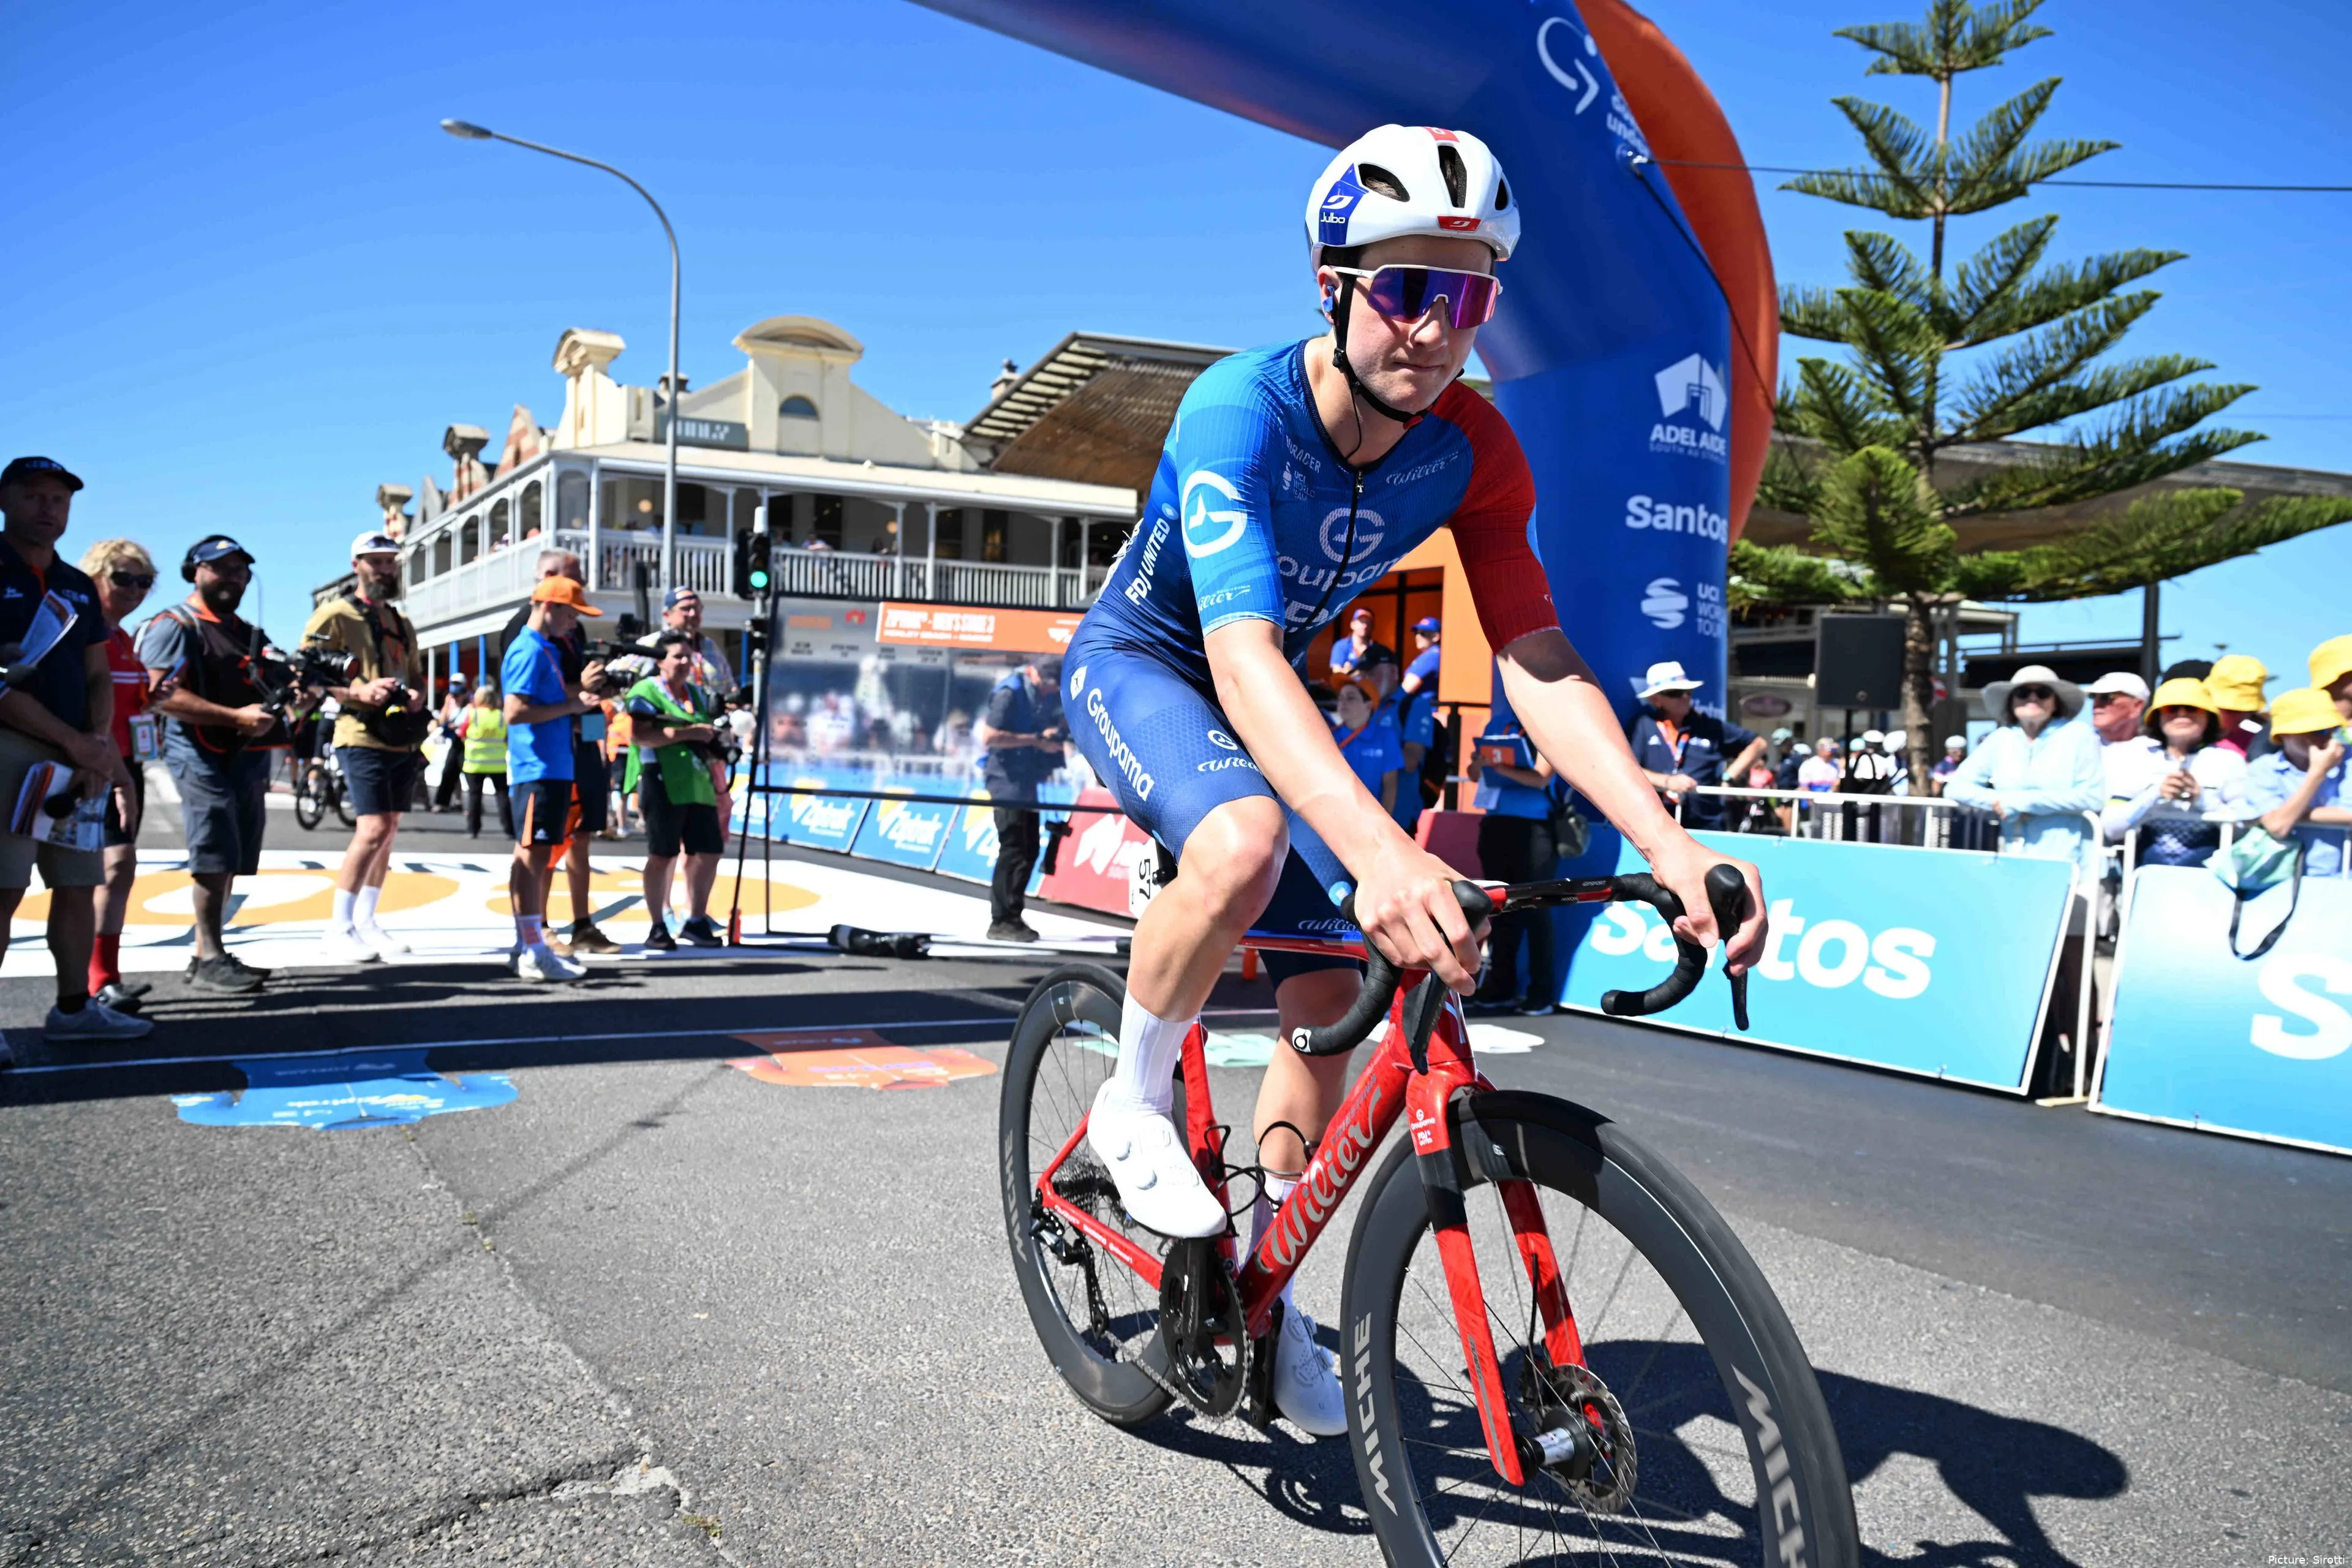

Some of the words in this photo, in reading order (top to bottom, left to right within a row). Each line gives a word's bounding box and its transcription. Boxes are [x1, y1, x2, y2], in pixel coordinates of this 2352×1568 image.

[1320, 211, 1346, 224] Julbo
[1294, 470, 1306, 483] UCI
[1125, 570, 1152, 606] FDJ
[1141, 518, 1170, 576] UNITED
[1199, 589, 1251, 612] ilier
[1087, 687, 1155, 802] Groupama
[1139, 858, 1151, 900] 57
[1590, 897, 1937, 1000] Satos
[1005, 1128, 1028, 1263] MICHE
[1255, 1085, 1382, 1275] Wilier
[1354, 1312, 1398, 1517] MICHE
